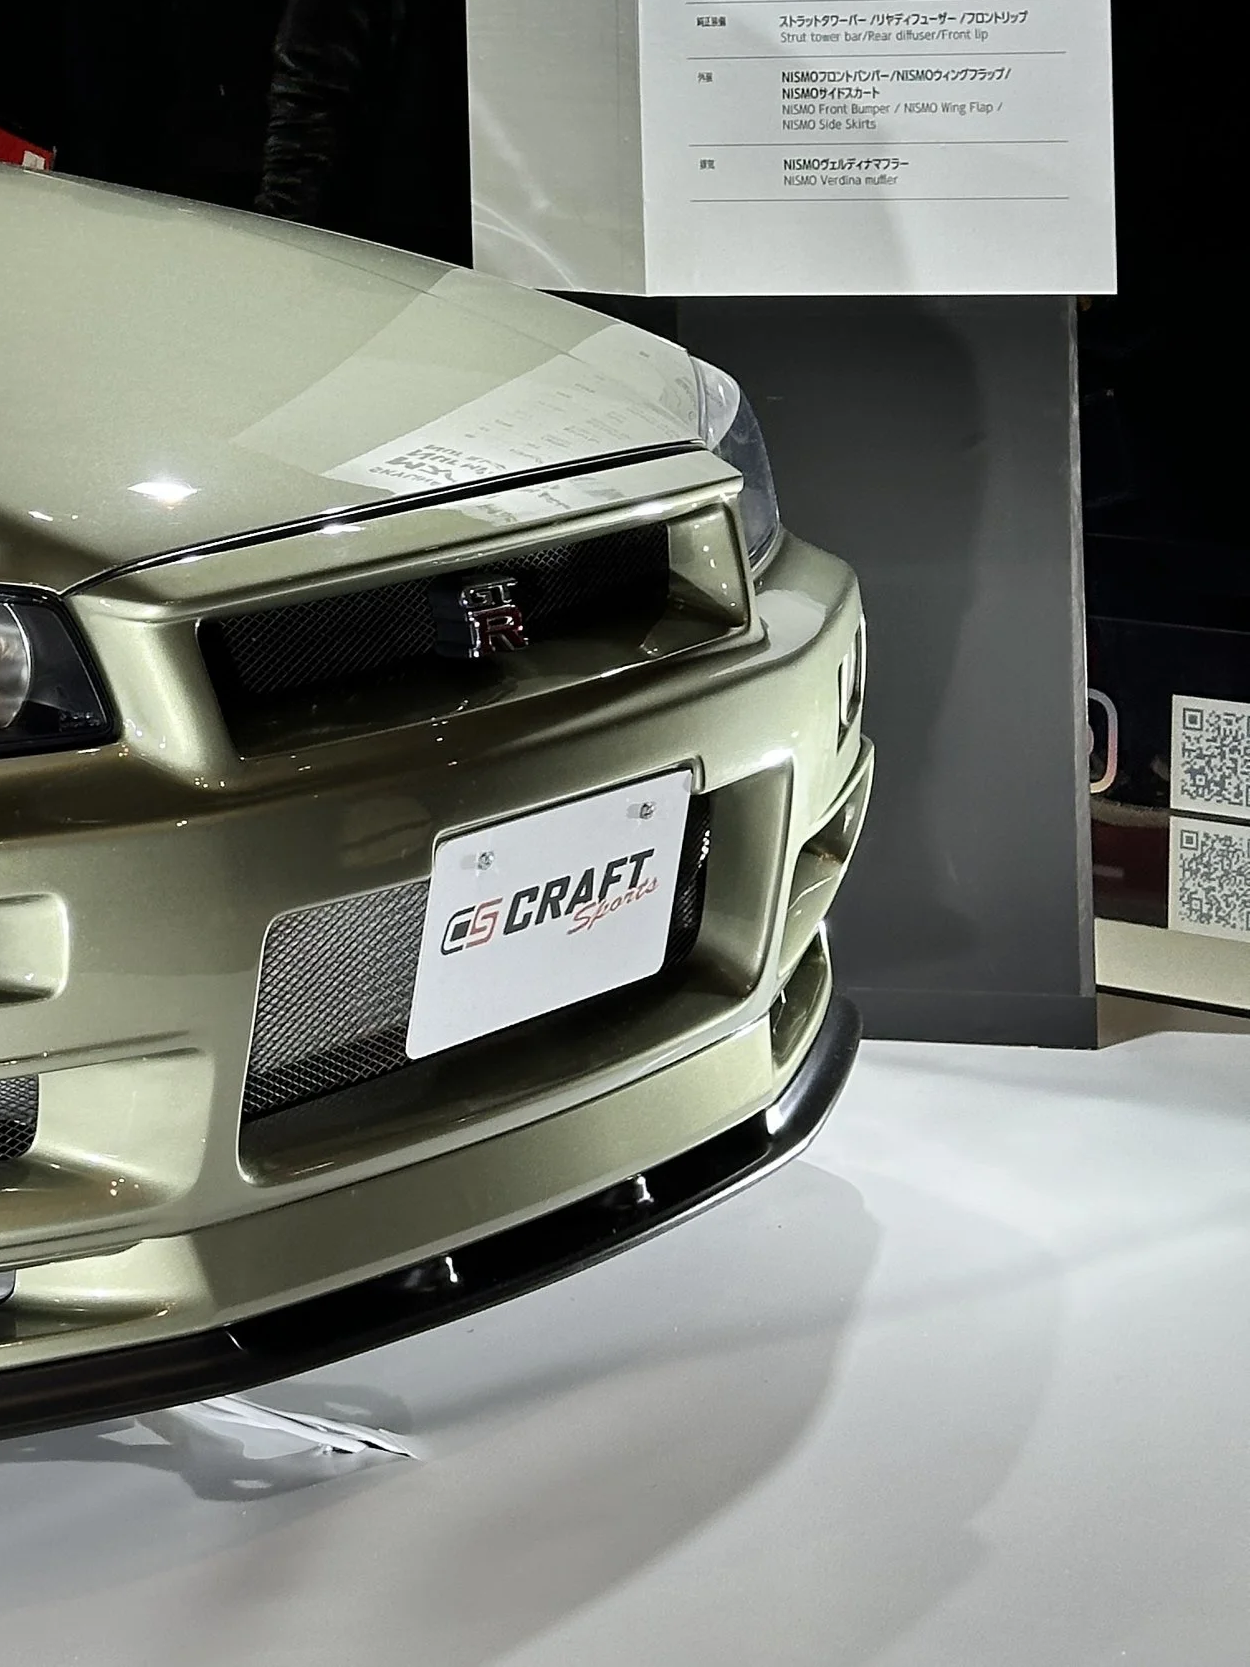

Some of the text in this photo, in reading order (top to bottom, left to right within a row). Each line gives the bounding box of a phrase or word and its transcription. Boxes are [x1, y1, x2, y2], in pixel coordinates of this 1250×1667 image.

[778, 14, 867, 28] ストラットタワーバー
[780, 31, 807, 43] Strut
[810, 32, 840, 43] tower
[781, 86, 881, 100] NISMOサイドスカート
[781, 104, 816, 115] NISMO
[819, 103, 847, 115] Front
[851, 102, 891, 116] Bumper
[903, 102, 938, 114] NISMO
[941, 101, 967, 116] Wing
[969, 101, 994, 114] Flap
[782, 117, 877, 131] NISMO Side Skirts
[783, 157, 910, 171] NISMOヴェルディナマフラー
[783, 174, 818, 186] NISMO
[820, 174, 862, 186] Verdina
[502, 847, 656, 936] CRAFT
[566, 876, 659, 935] Sports
